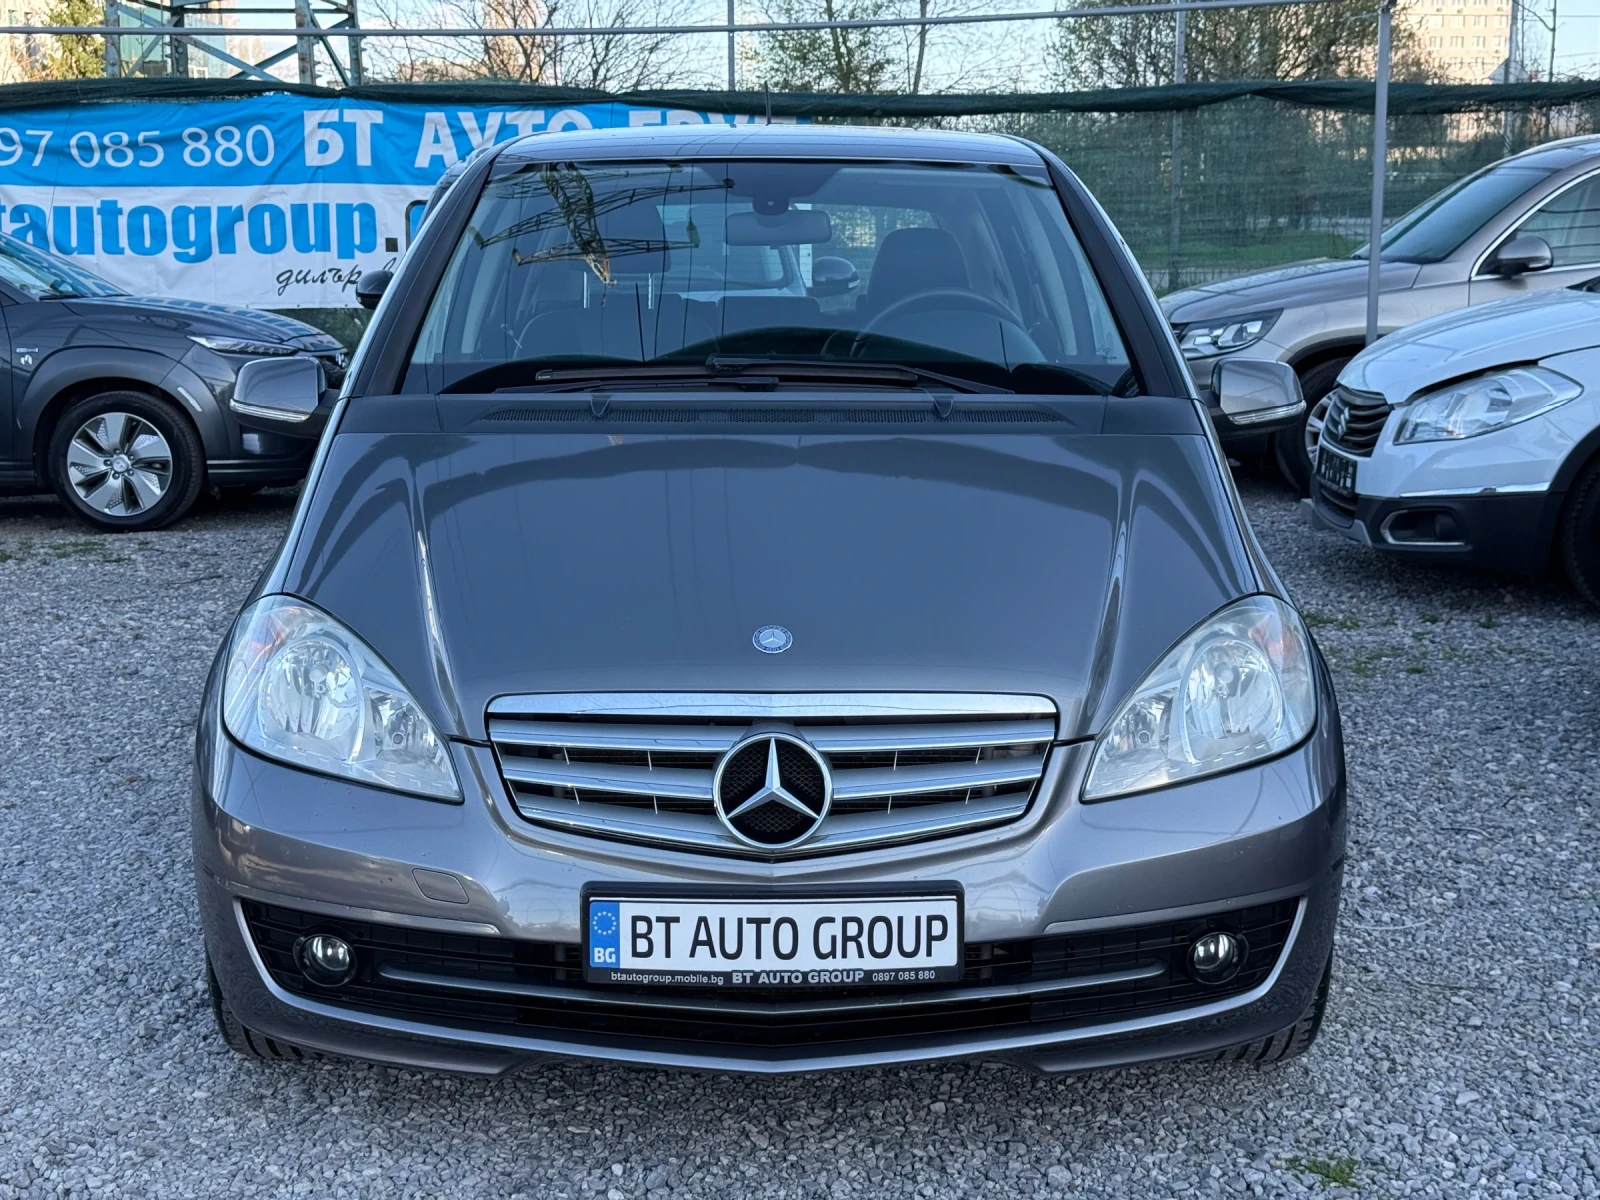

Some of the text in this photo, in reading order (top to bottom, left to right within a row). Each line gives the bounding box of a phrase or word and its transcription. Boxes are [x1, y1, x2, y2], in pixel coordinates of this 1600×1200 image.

[0, 124, 275, 168] 97 085 880
[303, 108, 384, 167] БТ
[276, 264, 362, 296] дилър
[593, 947, 616, 964] BG
[630, 914, 949, 960] BT AUTO GROUP
[611, 970, 936, 985] btautogroup.mobile.bg BT AUTO GROUP 0897 085 880
